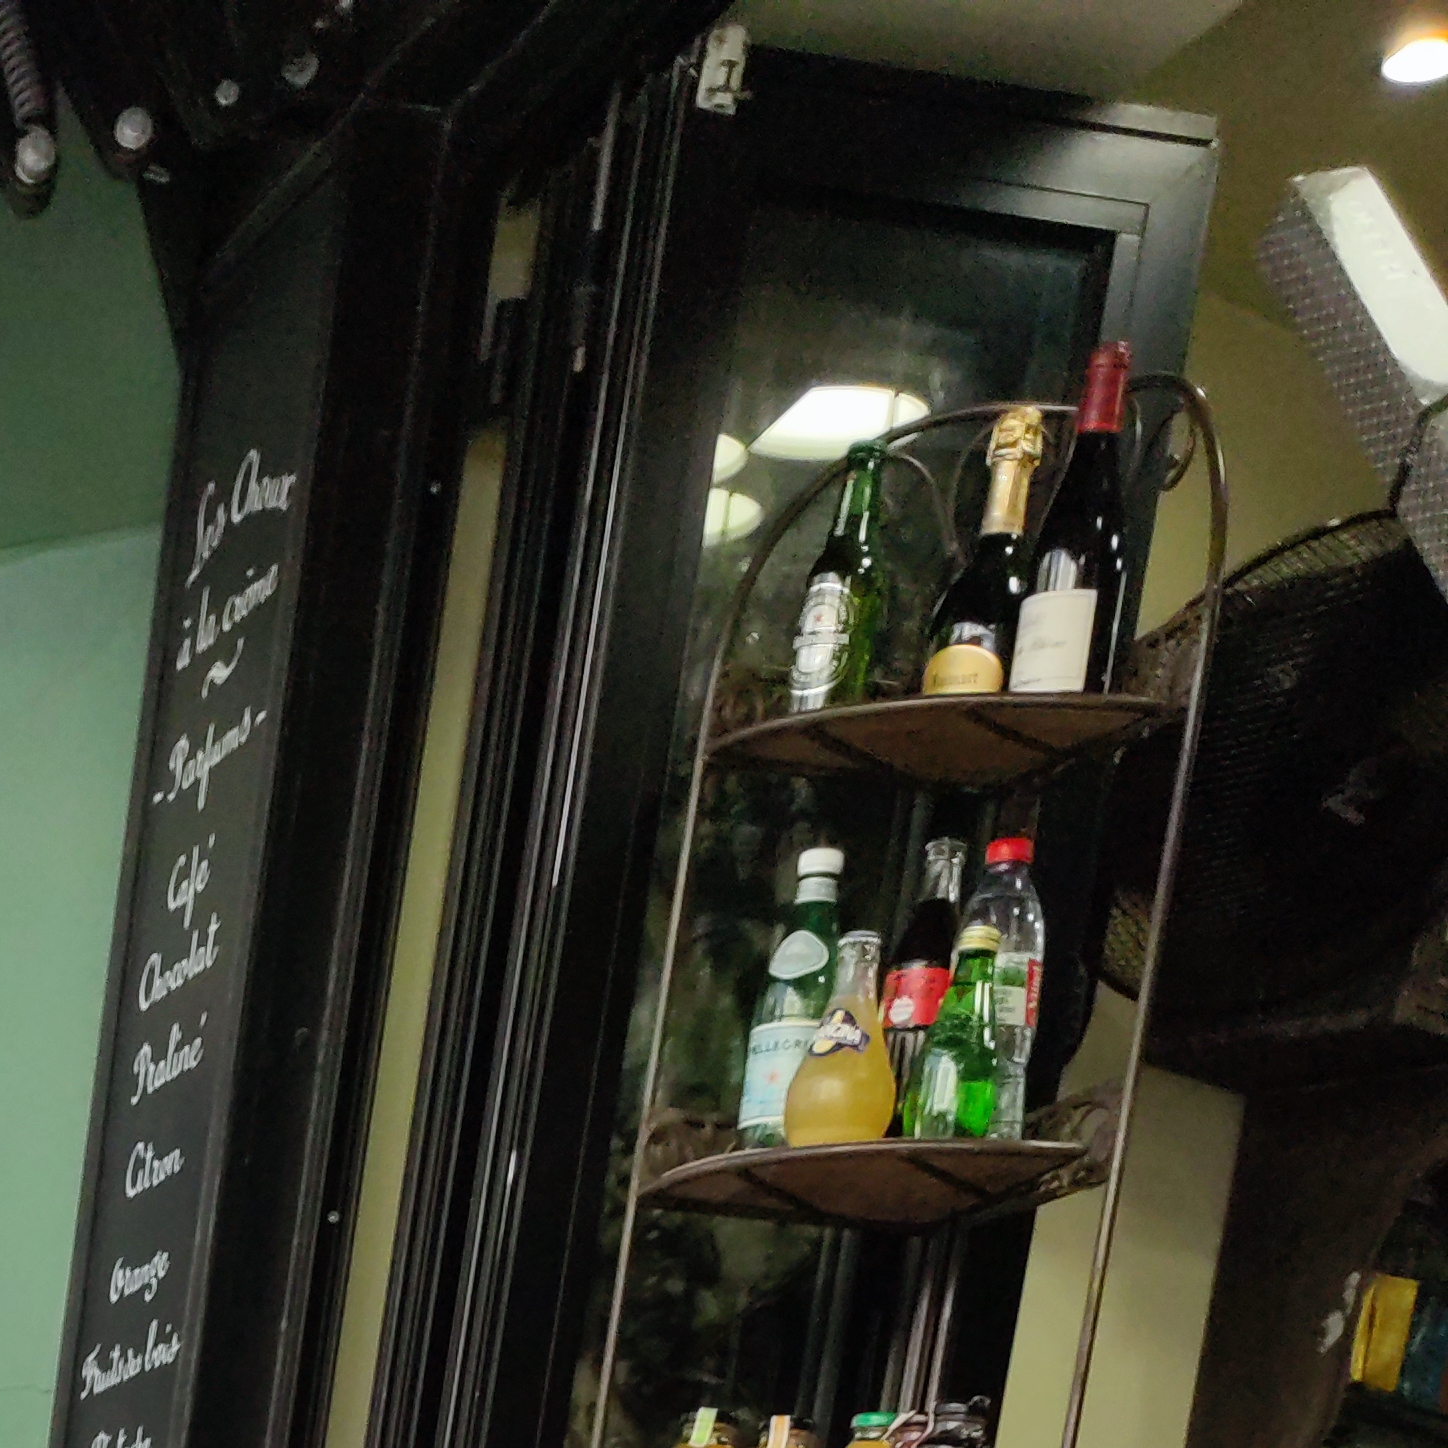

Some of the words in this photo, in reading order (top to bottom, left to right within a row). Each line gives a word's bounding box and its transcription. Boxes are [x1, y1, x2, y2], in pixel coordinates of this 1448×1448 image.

[167, 833, 215, 930] Café
[130, 1010, 207, 1106] Praliné
[125, 1141, 185, 1198] Citron
[109, 1250, 171, 1304] Orange
